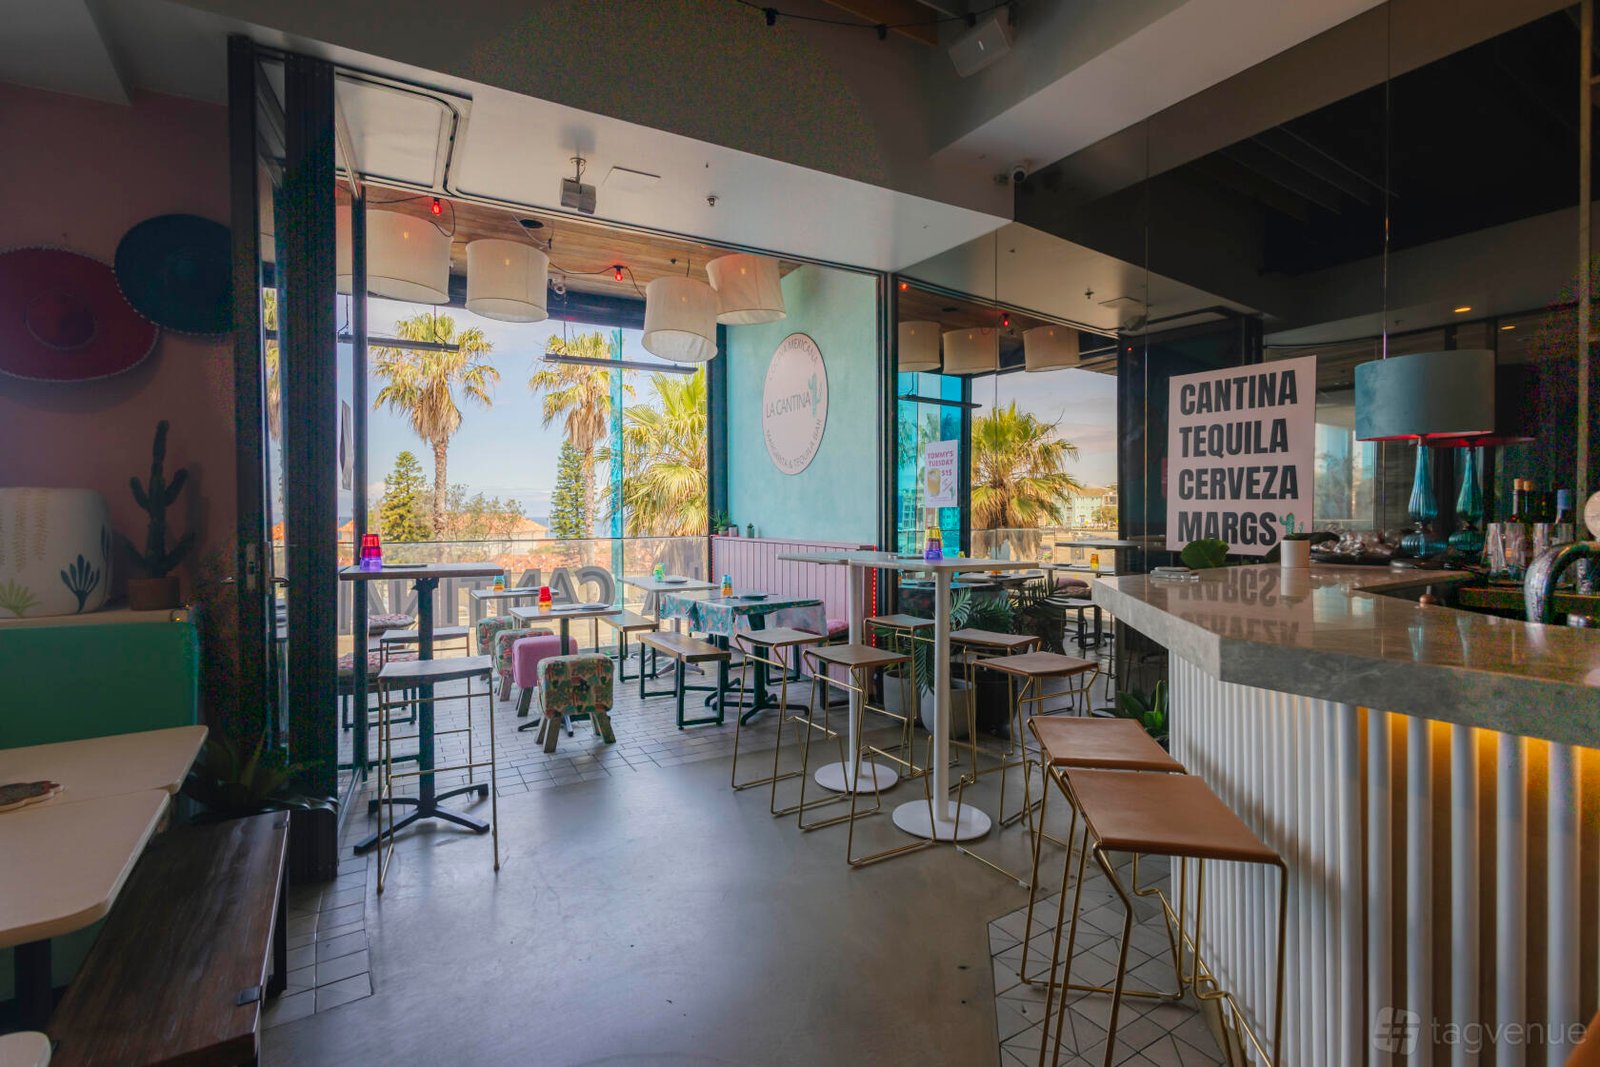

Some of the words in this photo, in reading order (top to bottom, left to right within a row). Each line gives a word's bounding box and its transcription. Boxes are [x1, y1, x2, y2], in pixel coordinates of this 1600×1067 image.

[766, 401, 775, 418] LA
[775, 391, 811, 416] CANTINA
[1180, 370, 1298, 415] CANTINA
[927, 450, 954, 459] TOMMY'S
[1178, 418, 1289, 459] TEQUILA
[928, 459, 953, 467] TUESDAY
[1178, 465, 1299, 500] CERVEZA
[1177, 511, 1277, 546] MARGS
